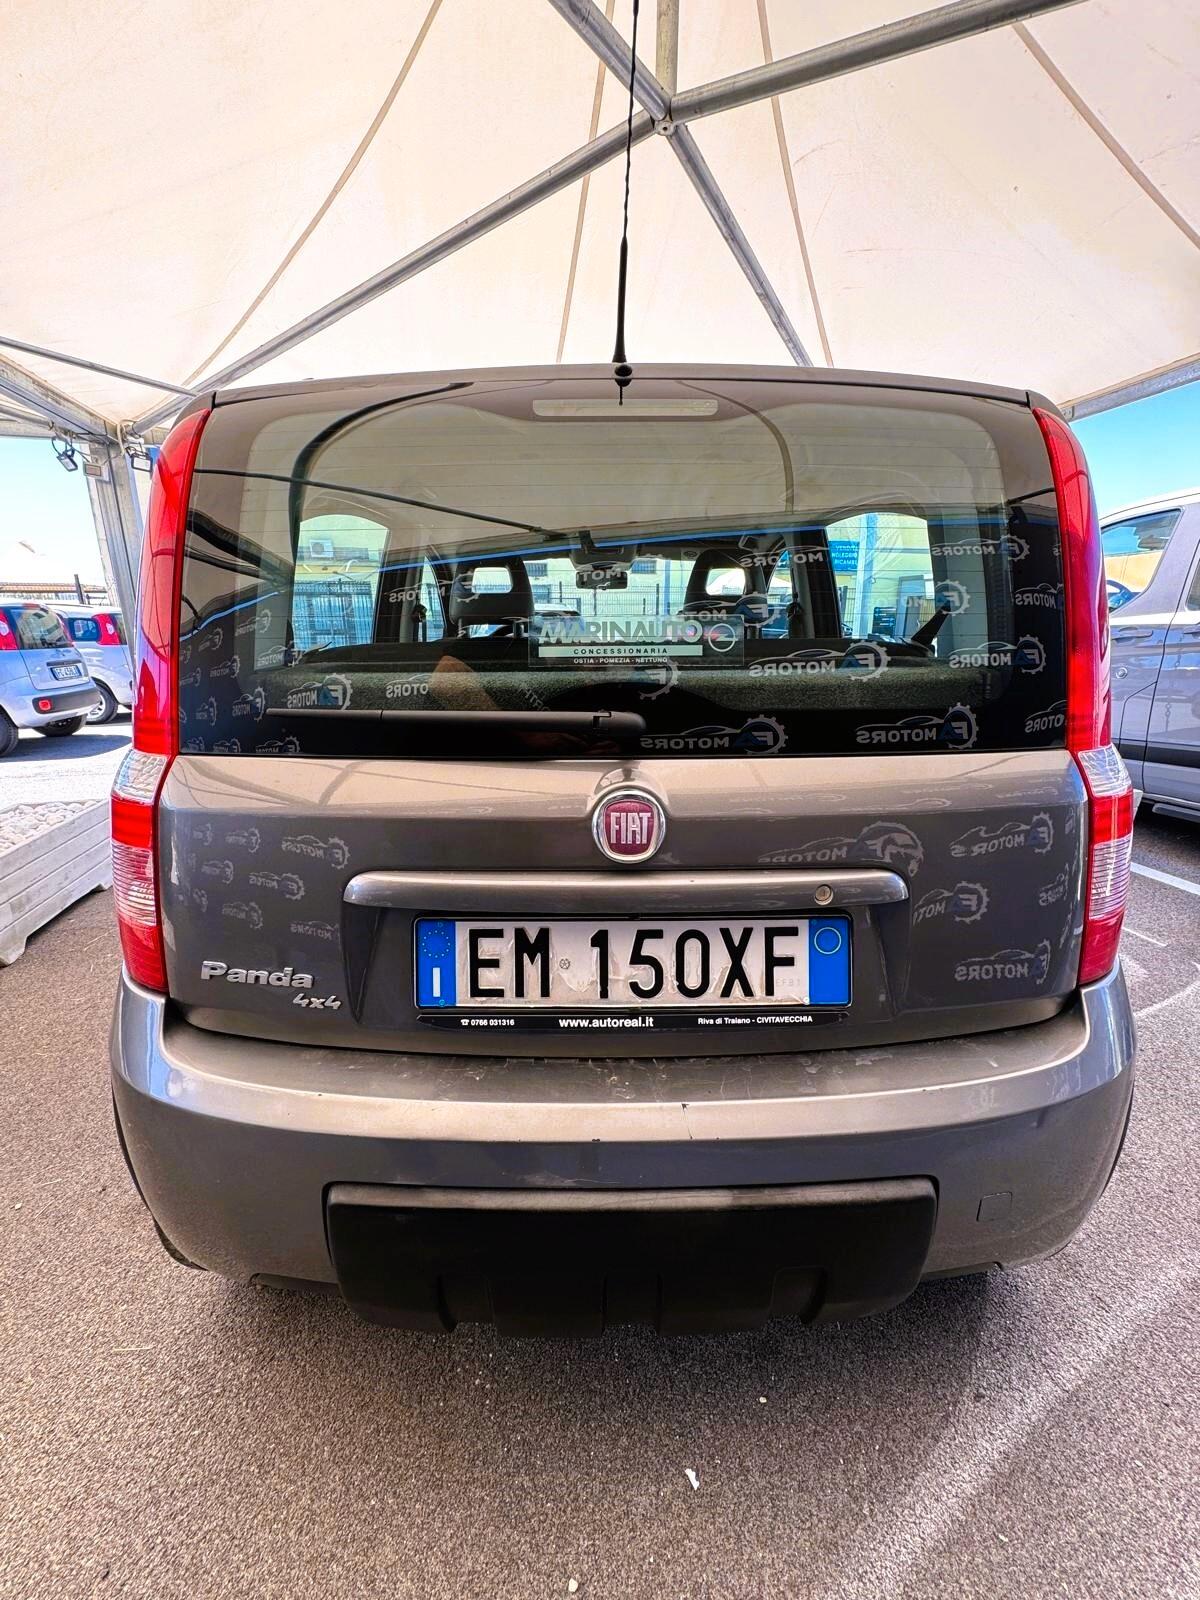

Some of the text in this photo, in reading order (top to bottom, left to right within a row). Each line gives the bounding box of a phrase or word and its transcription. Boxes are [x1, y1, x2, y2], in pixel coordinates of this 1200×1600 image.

[538, 619, 703, 644] MARINAUTO
[610, 812, 652, 844] FIAT
[469, 926, 799, 999] EM 150XF
[200, 960, 314, 989] Panda
[292, 993, 342, 1010] 4x4
[470, 1018, 515, 1026] 0766 031316
[558, 1016, 654, 1028] www.autoreal.it
[756, 1016, 813, 1024] CIVITAVECCHIA
